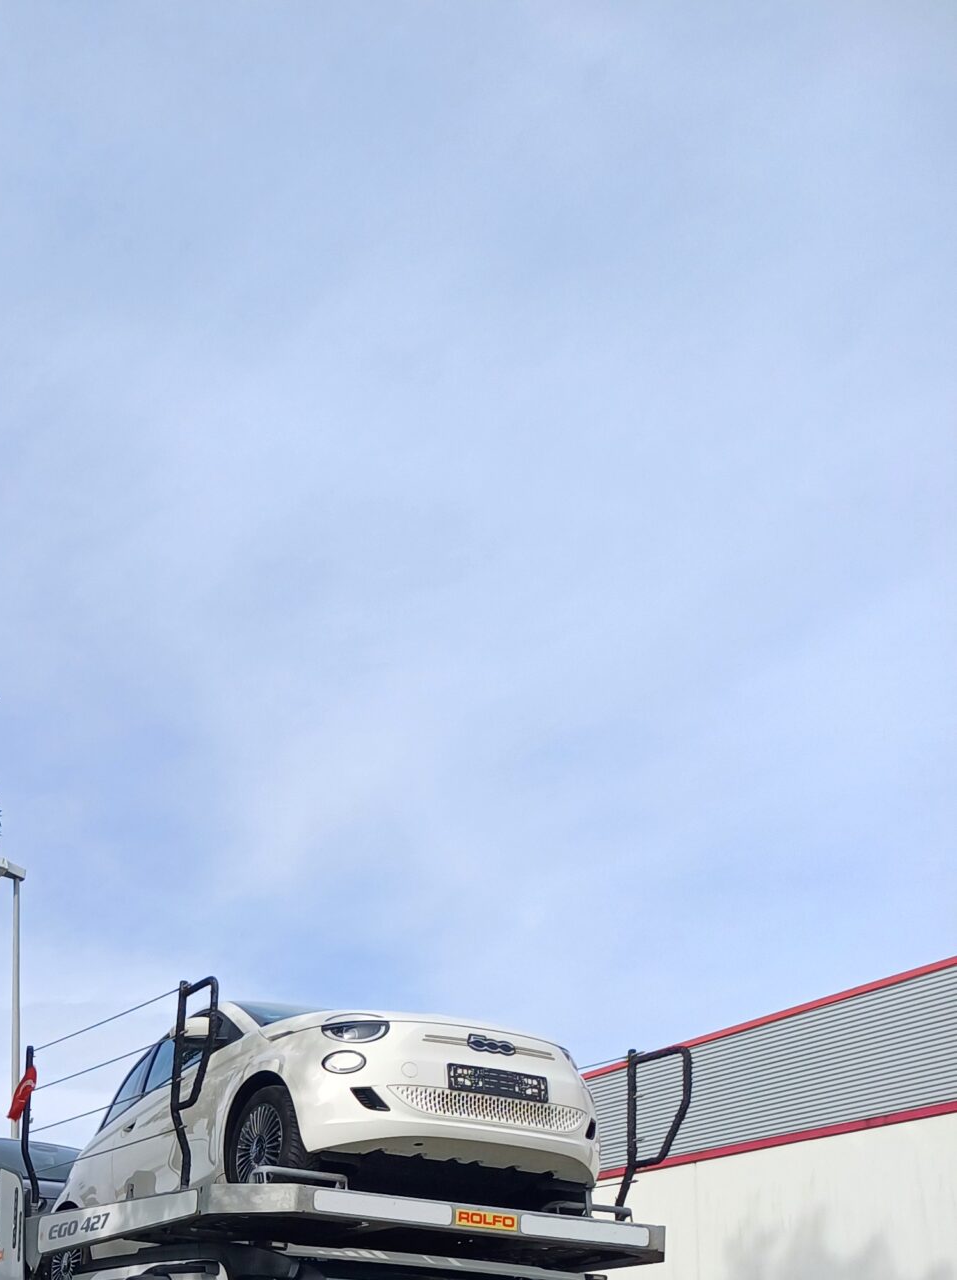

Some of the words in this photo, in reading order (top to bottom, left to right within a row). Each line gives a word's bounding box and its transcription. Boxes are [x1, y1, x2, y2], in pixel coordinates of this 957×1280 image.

[48, 1220, 78, 1240] EGO
[80, 1212, 110, 1232] 427
[458, 1211, 515, 1228] ROLFO
